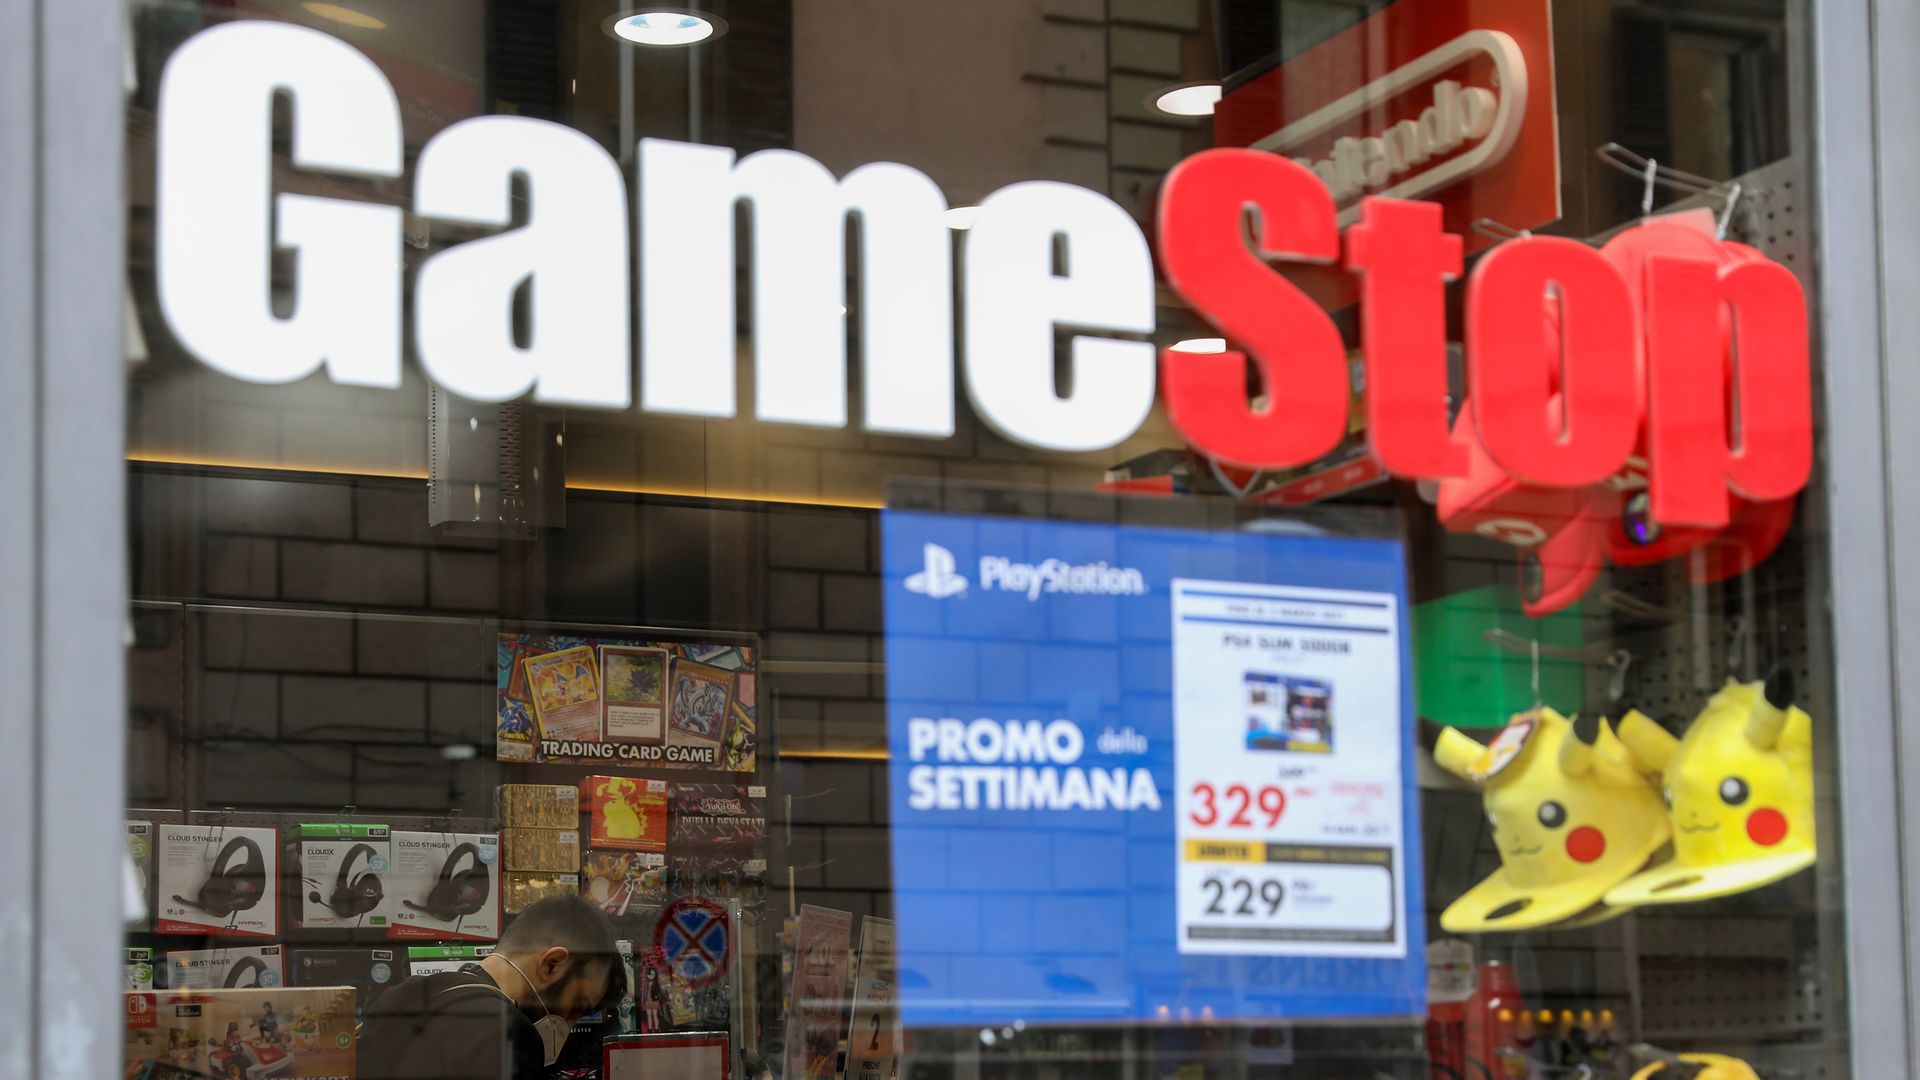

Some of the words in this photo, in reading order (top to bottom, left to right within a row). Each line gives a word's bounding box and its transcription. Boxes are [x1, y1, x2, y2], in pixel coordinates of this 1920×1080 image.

[157, 20, 1813, 528] GameStop
[979, 554, 1147, 602] PlayStation
[540, 740, 613, 757] TRADING
[618, 744, 661, 760] CARD
[666, 746, 713, 763] GAME
[907, 717, 1084, 765] PROMO
[1097, 727, 1148, 755] della
[907, 765, 1163, 811] SETTIMANA
[1189, 783, 1288, 830] 329
[192, 835, 223, 843] STINGER
[717, 817, 766, 827] DEVASTATI
[307, 848, 335, 856] CLOUDX
[421, 841, 451, 849] STINGER
[1202, 878, 1285, 917] 229
[175, 960, 199, 968] CLOUD
[200, 958, 230, 966] STINGER
[868, 1013, 880, 1051] 2
